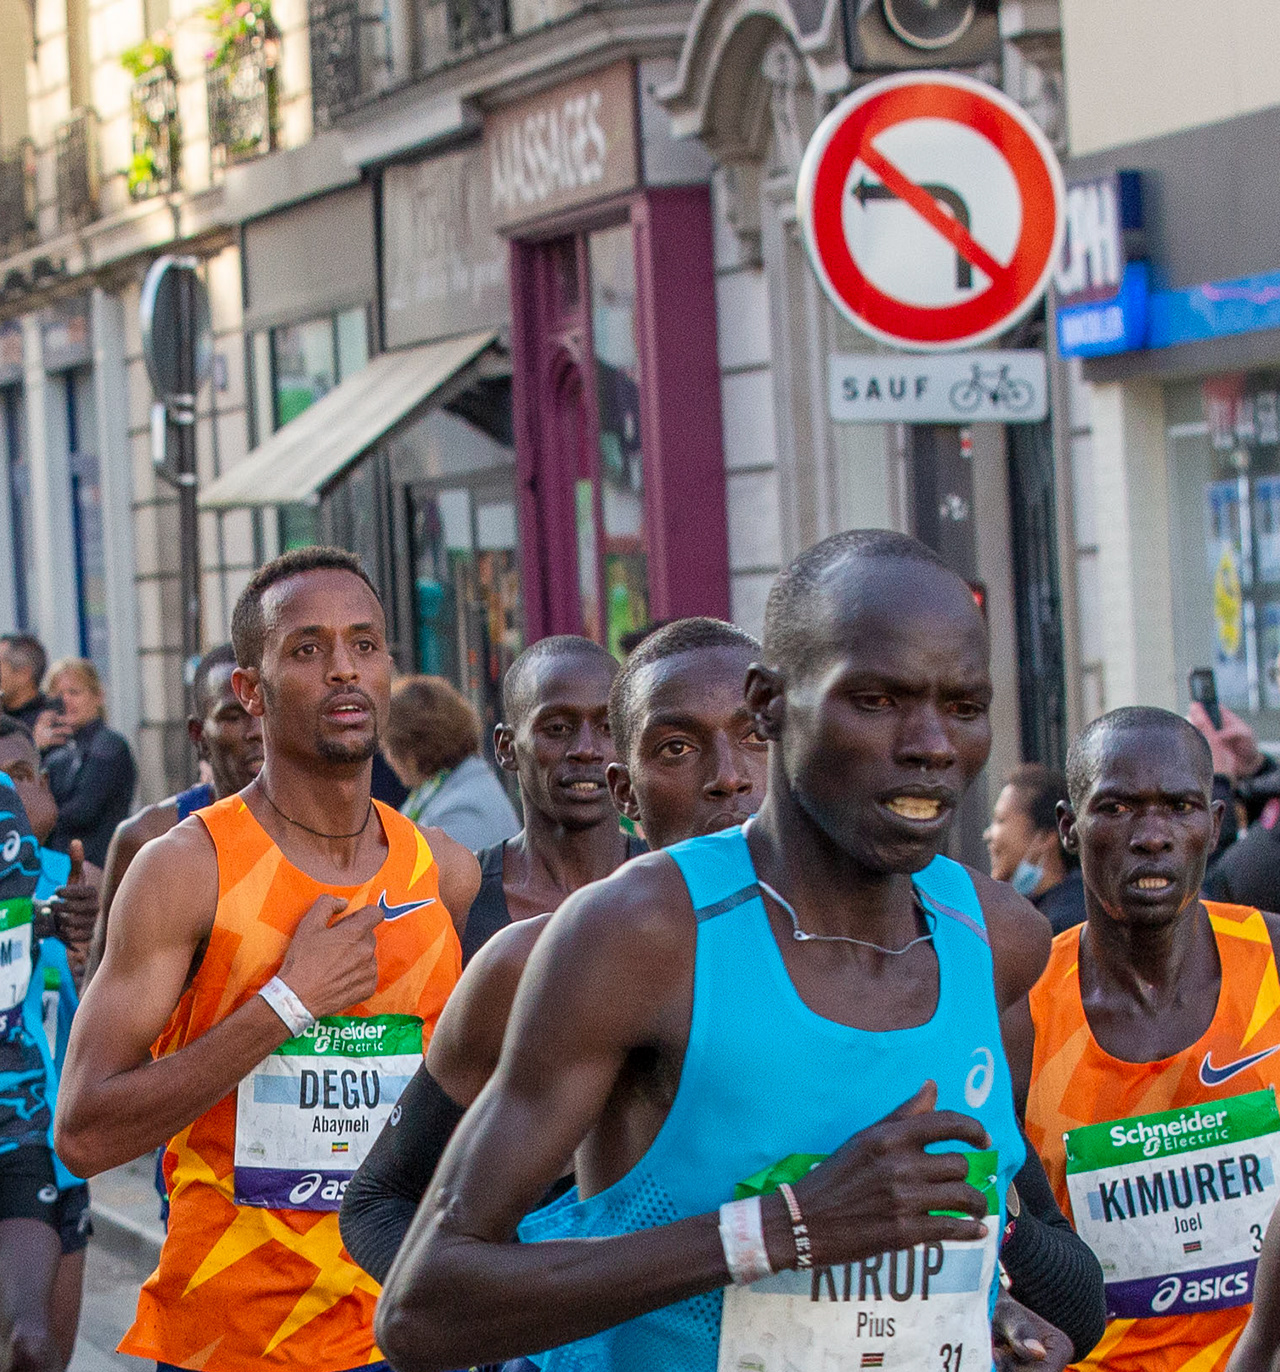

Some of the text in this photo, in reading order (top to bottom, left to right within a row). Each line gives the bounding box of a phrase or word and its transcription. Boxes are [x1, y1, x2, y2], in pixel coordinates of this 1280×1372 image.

[841, 375, 929, 402] SAUF
[333, 1039, 384, 1052] Electric
[299, 1069, 380, 1110] DEGU
[312, 1115, 369, 1136] Abayneh
[1110, 1110, 1228, 1147] Schneider
[1164, 1128, 1229, 1151] Electric
[1098, 1153, 1265, 1223] KIMURER
[1174, 1212, 1202, 1234] Joel
[1249, 1224, 1263, 1253] 3
[1183, 1271, 1249, 1303] asics
[857, 1312, 896, 1337] Pius
